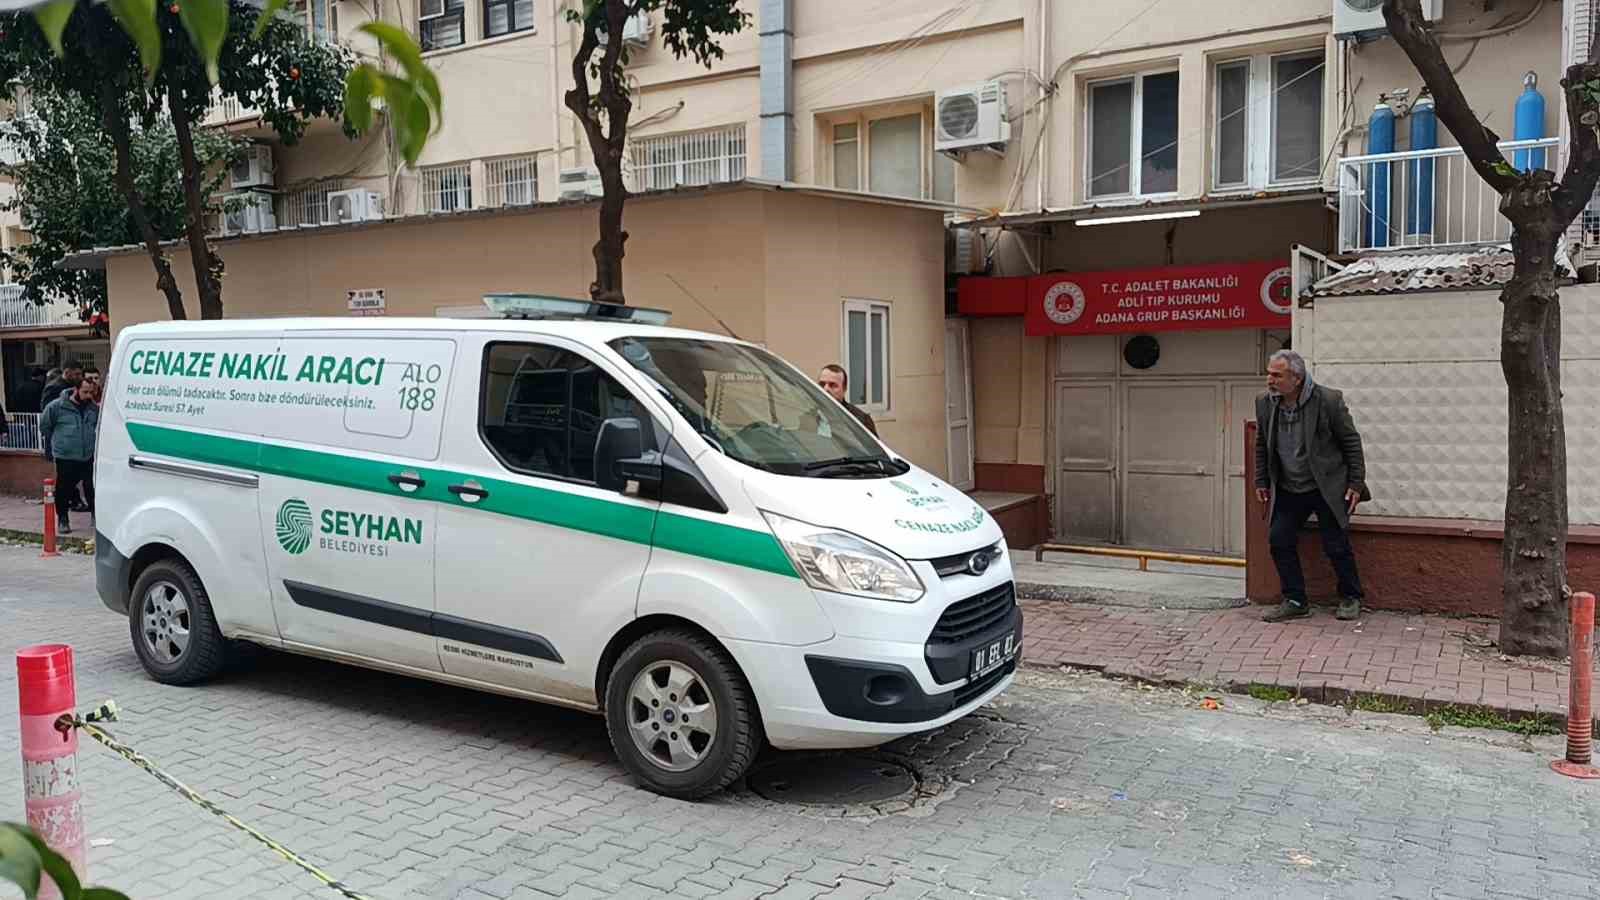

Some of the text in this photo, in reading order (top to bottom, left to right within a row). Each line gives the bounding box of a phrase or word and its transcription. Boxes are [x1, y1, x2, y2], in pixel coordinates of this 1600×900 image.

[1101, 274, 1238, 293] T.C. ADALET BAKANLIĞI
[1118, 293, 1221, 308] ADLİ TIP KURUMU
[1095, 304, 1245, 324] ADANA GRUP BAŞKANLIĞI
[129, 346, 386, 386] CENAZE NAKİL ARACI
[400, 362, 442, 384] ALO
[127, 384, 141, 394] Her
[141, 386, 156, 396] can
[229, 389, 256, 402] Sonra
[258, 391, 278, 404] bize
[398, 387, 436, 411] 188
[186, 405, 206, 417] Ayet
[319, 509, 423, 544] SEYHAN
[319, 538, 389, 557] BELEDİYESİ
[975, 650, 986, 671] 01
